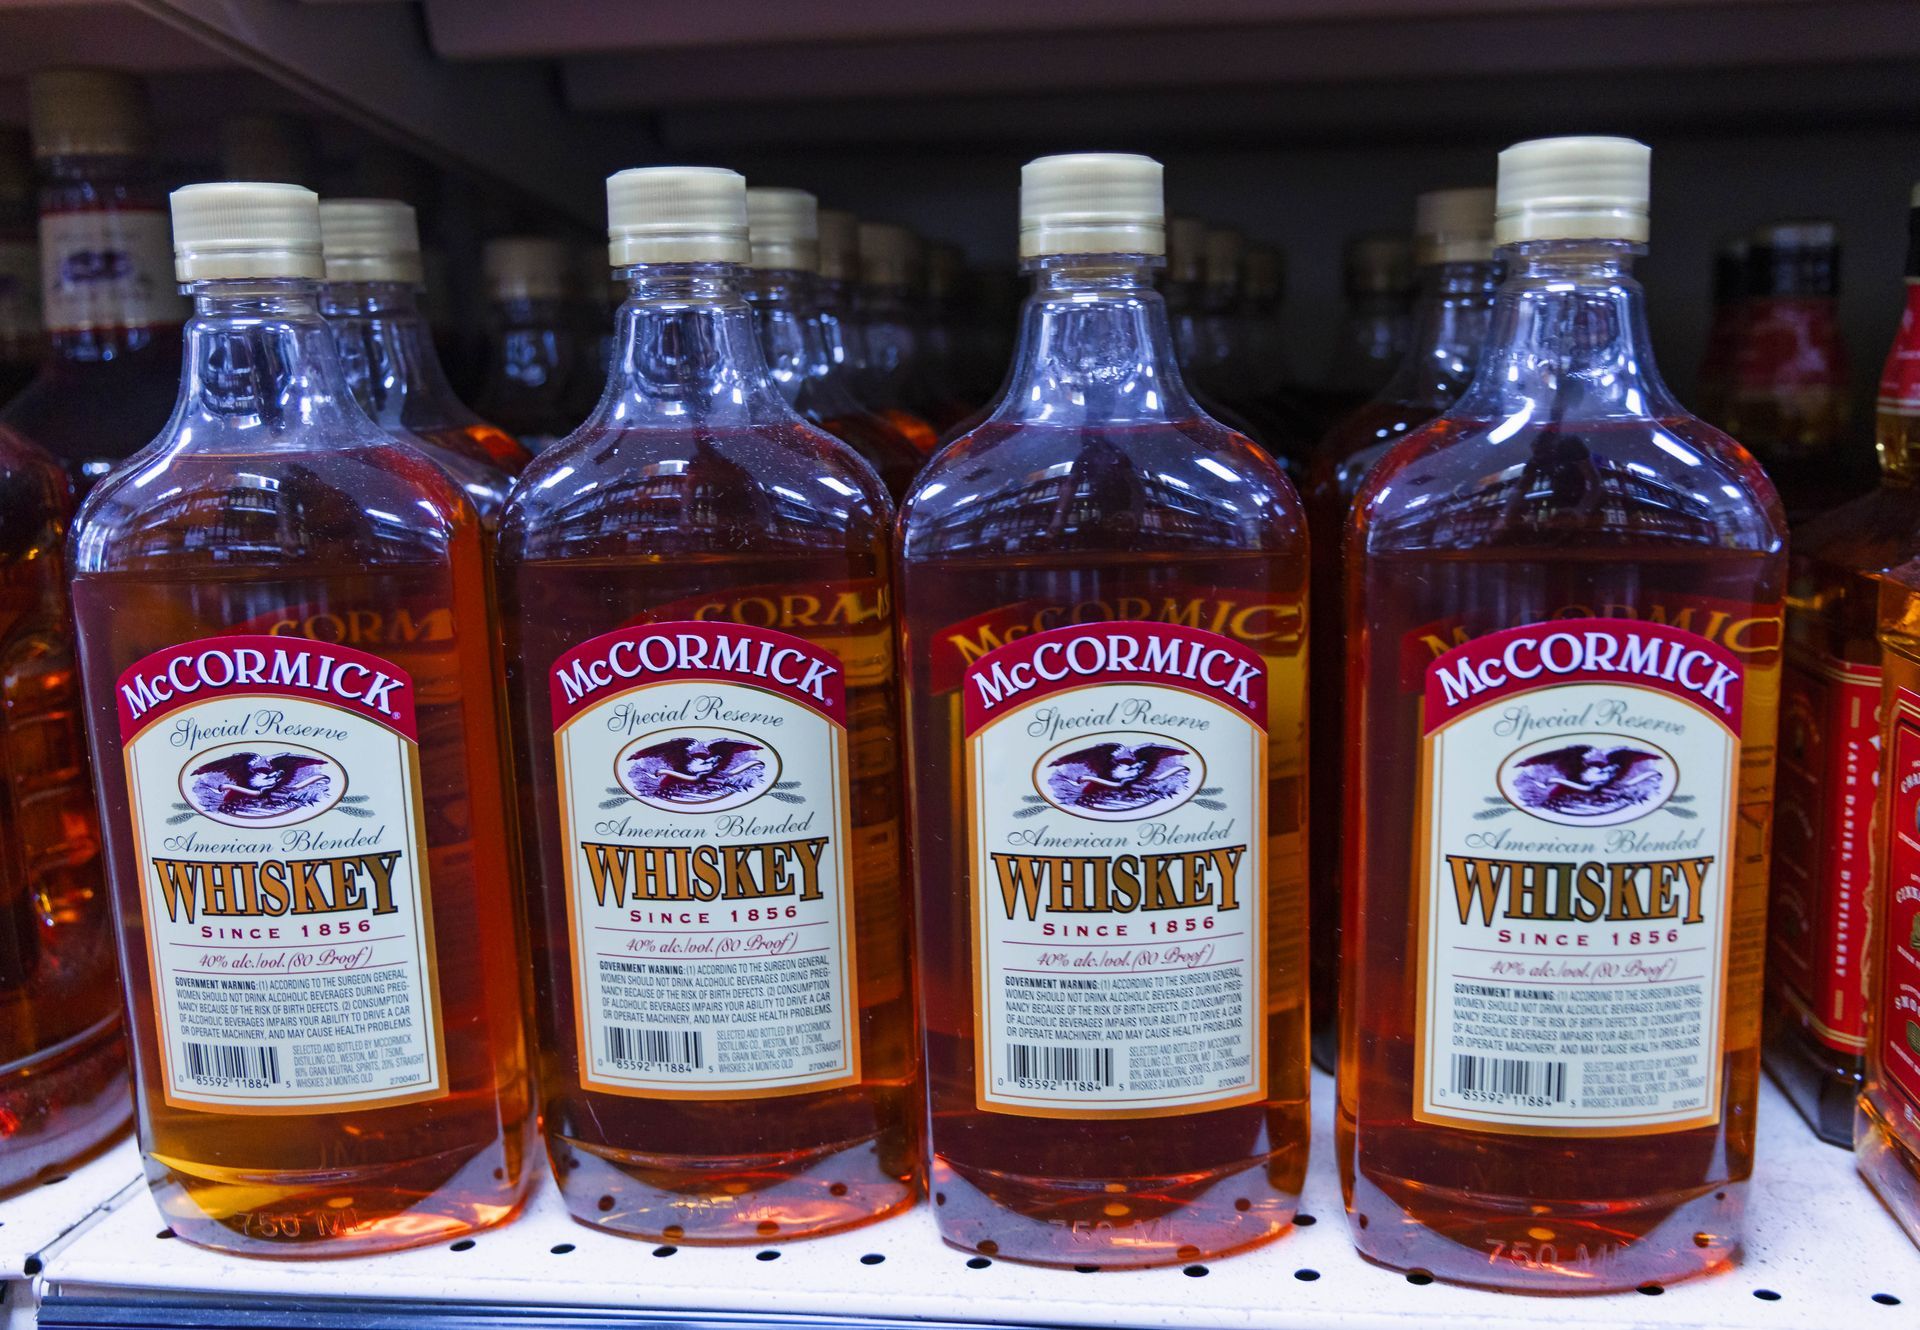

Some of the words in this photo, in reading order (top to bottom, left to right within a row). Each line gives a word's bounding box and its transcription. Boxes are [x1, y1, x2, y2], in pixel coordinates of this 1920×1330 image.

[556, 633, 837, 704] McCORMICK
[971, 635, 1261, 709] McCORMICK
[1435, 632, 1739, 707] McCORMICK
[121, 648, 404, 719] McCORMICK
[607, 700, 691, 735] Special
[694, 695, 785, 727] Reserve
[1026, 702, 1119, 740] Special
[1121, 698, 1211, 732] Reserve
[1493, 702, 1594, 741] Special
[1595, 699, 1687, 736] Reserve
[170, 713, 251, 750] Special
[255, 709, 348, 742] Reserve
[594, 815, 707, 839] American
[715, 811, 815, 838] Blended
[1007, 824, 1129, 848] American
[1137, 818, 1235, 847] Blended
[163, 830, 273, 854] American
[281, 825, 386, 853] Blended
[1464, 828, 1595, 854] American
[1604, 828, 1705, 854] Blended
[581, 836, 829, 908] WHISKEY
[991, 844, 1247, 921] WHISKEY
[152, 850, 402, 924] WHISKEY
[1445, 855, 1714, 928] WHISKEY
[630, 910, 709, 924] SINCE
[731, 905, 797, 922] 1856
[201, 926, 280, 939] SINCE
[301, 920, 371, 938] 1856
[1043, 923, 1128, 937] SINCE
[1150, 916, 1214, 935] 1856
[1498, 929, 1588, 946] SINCE
[1612, 929, 1678, 945] 1856
[626, 939, 656, 953] 40%
[199, 953, 228, 968] 40%
[600, 960, 646, 973] GOVERNMENT
[648, 964, 686, 975] WARNING:
[1036, 951, 1069, 967] 40%
[175, 977, 218, 989] GOVERNMENT
[221, 980, 258, 990] WARNING:
[259, 980, 268, 991] (1)
[270, 979, 310, 990] ACCORDING
[312, 978, 321, 988] TO
[323, 977, 336, 987] THE
[338, 973, 372, 986] SURGEON
[374, 969, 407, 982] GENERAL,
[1005, 975, 1057, 989] GOVERNMENT
[1453, 983, 1511, 998] GOVERNMENT
[176, 989, 200, 1000] WOMEN
[202, 992, 227, 1001] SHOULD
[229, 993, 243, 1002] NOT
[245, 993, 266, 1002] DRINK
[268, 991, 308, 1002] ALCOHOLIC
[311, 988, 354, 1001] BEVERAGES
[356, 984, 385, 997] DURING
[388, 981, 410, 992] PREG-
[178, 1001, 198, 1011] NANCY
[200, 1003, 229, 1014] BECAUSE
[230, 1004, 239, 1014] OF
[240, 1005, 253, 1014] THE
[255, 1005, 271, 1014] RISK
[273, 1005, 281, 1014] OF
[284, 1004, 304, 1014] BIRTH
[307, 1002, 339, 1013] DEFECTS.
[342, 1001, 351, 1011] (2)
[353, 993, 409, 1009] CONSUMPTION
[180, 1014, 187, 1022] OF
[188, 1015, 222, 1026] ALCOHOLIC
[224, 1017, 264, 1027] BEVERAGES
[266, 1017, 298, 1027] IMPAIRS
[299, 1016, 320, 1026] YOUR
[322, 1014, 349, 1025] ABILITY
[351, 1012, 361, 1022] TO
[363, 1009, 385, 1020] DRIVE
[388, 1008, 393, 1017] A
[395, 1005, 410, 1016] CAR
[182, 1026, 190, 1035] OR
[191, 1026, 220, 1038] OPERATE
[222, 1030, 266, 1040] MACHINERY,
[268, 1030, 285, 1039] AND
[288, 1029, 304, 1039] MAY
[307, 1026, 333, 1038] CAUSE
[335, 1023, 366, 1035] HEALTH
[368, 1017, 412, 1032] PROBLEMS.
[597, 1058, 603, 1067] 0
[616, 1059, 650, 1071] 85592
[657, 1061, 692, 1073] 11884
[178, 1074, 184, 1083] 0
[196, 1076, 229, 1088] 85592
[234, 1077, 270, 1089] 11884
[286, 1080, 291, 1089] 5
[1019, 1078, 1056, 1090] 85592
[1064, 1080, 1101, 1092] 11884
